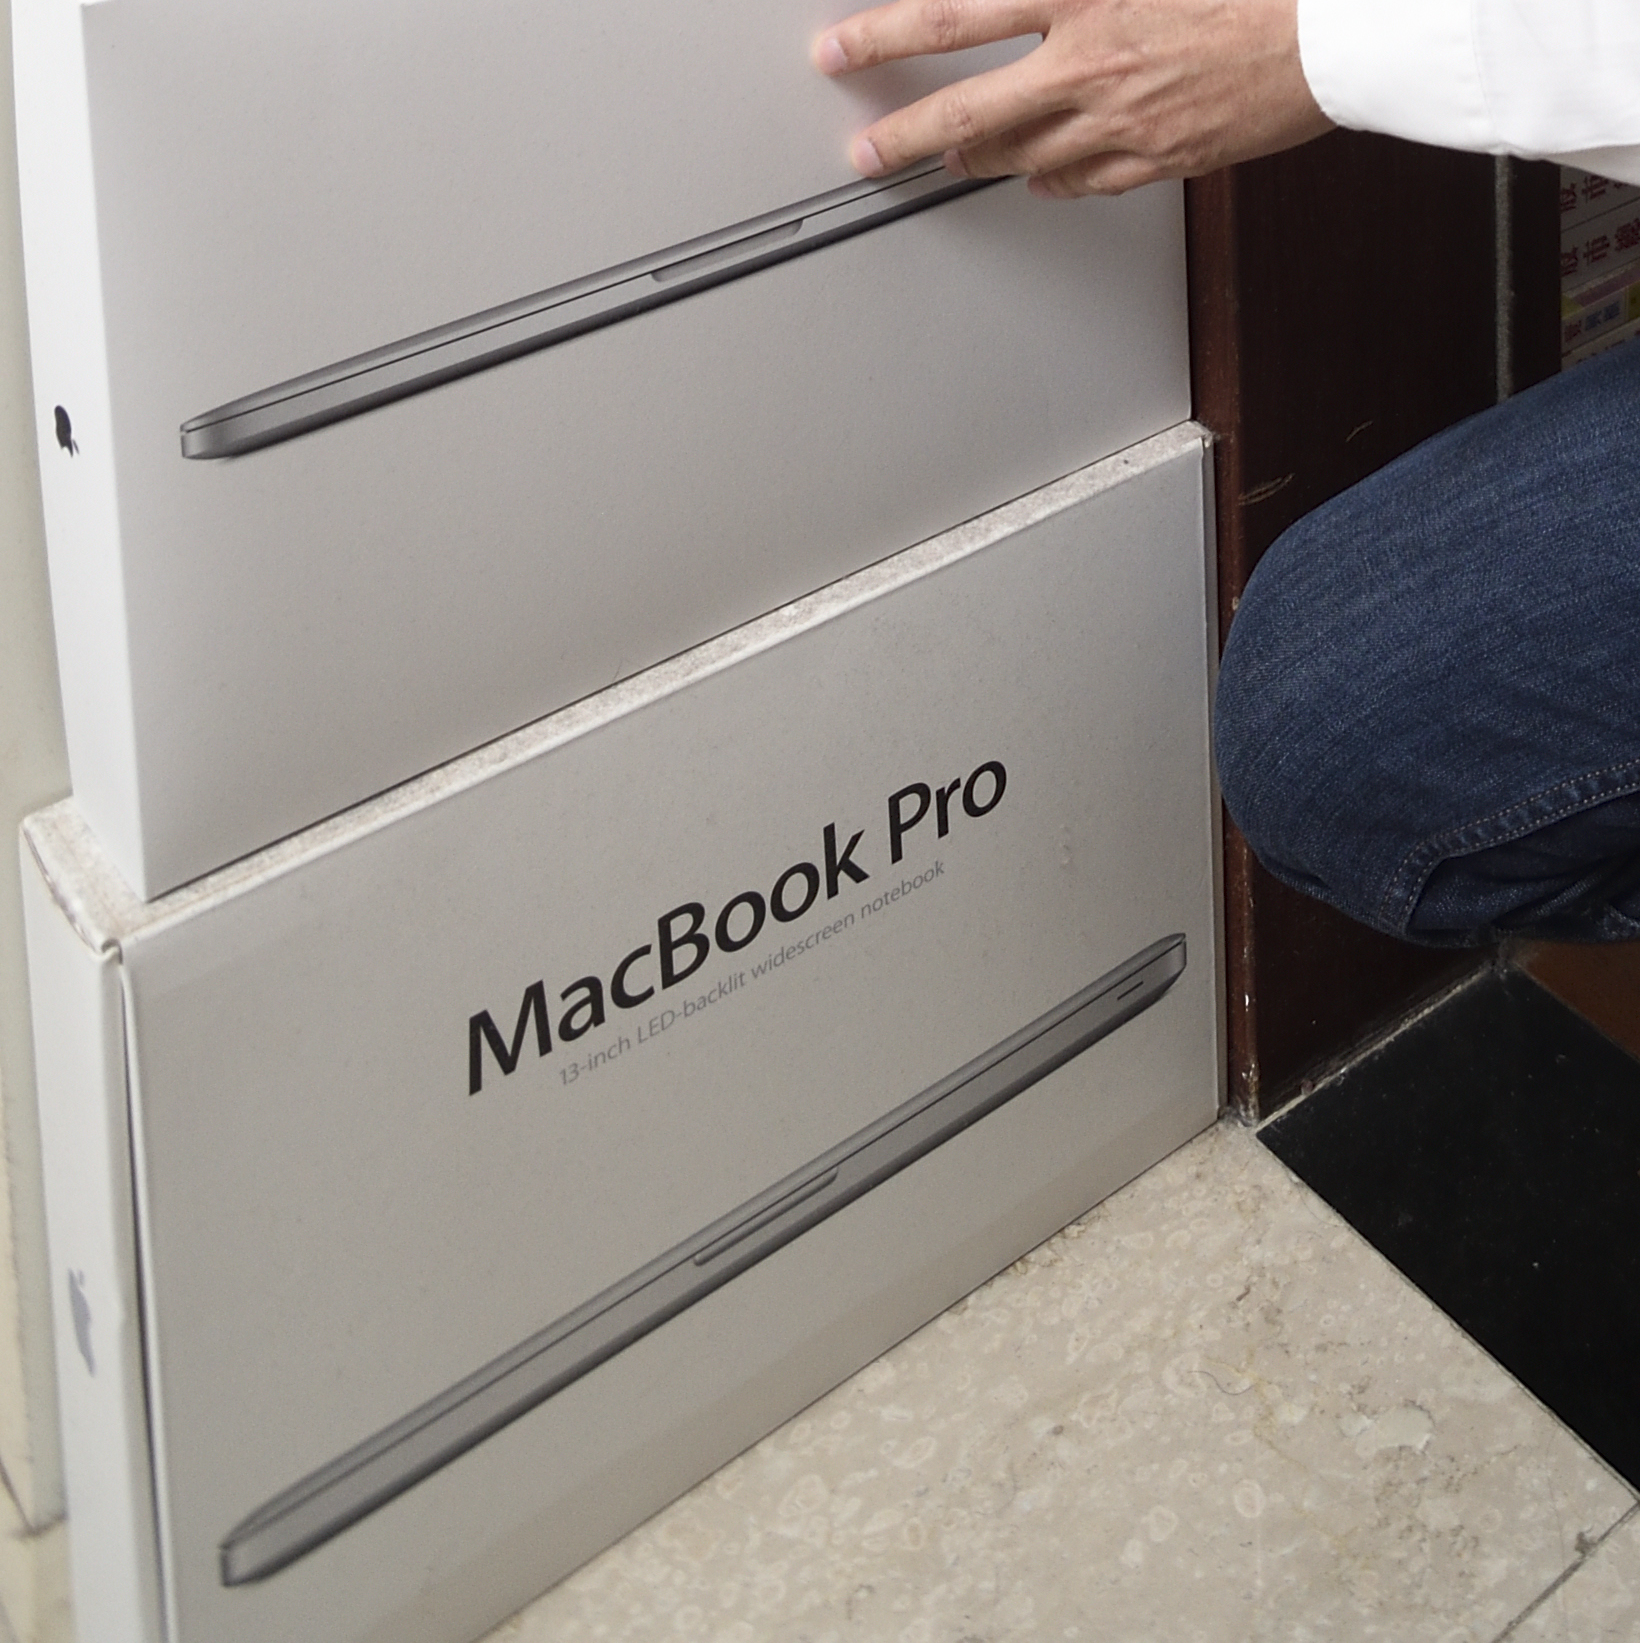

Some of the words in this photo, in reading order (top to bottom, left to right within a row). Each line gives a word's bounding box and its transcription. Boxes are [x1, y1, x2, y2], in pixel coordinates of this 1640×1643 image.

[469, 822, 870, 1096] MacBook
[887, 760, 1007, 864] Pro
[559, 1037, 631, 1086] 13-inch
[637, 971, 746, 1045] LED-backlit
[751, 915, 855, 980] widescreen
[860, 860, 945, 920] notebook
